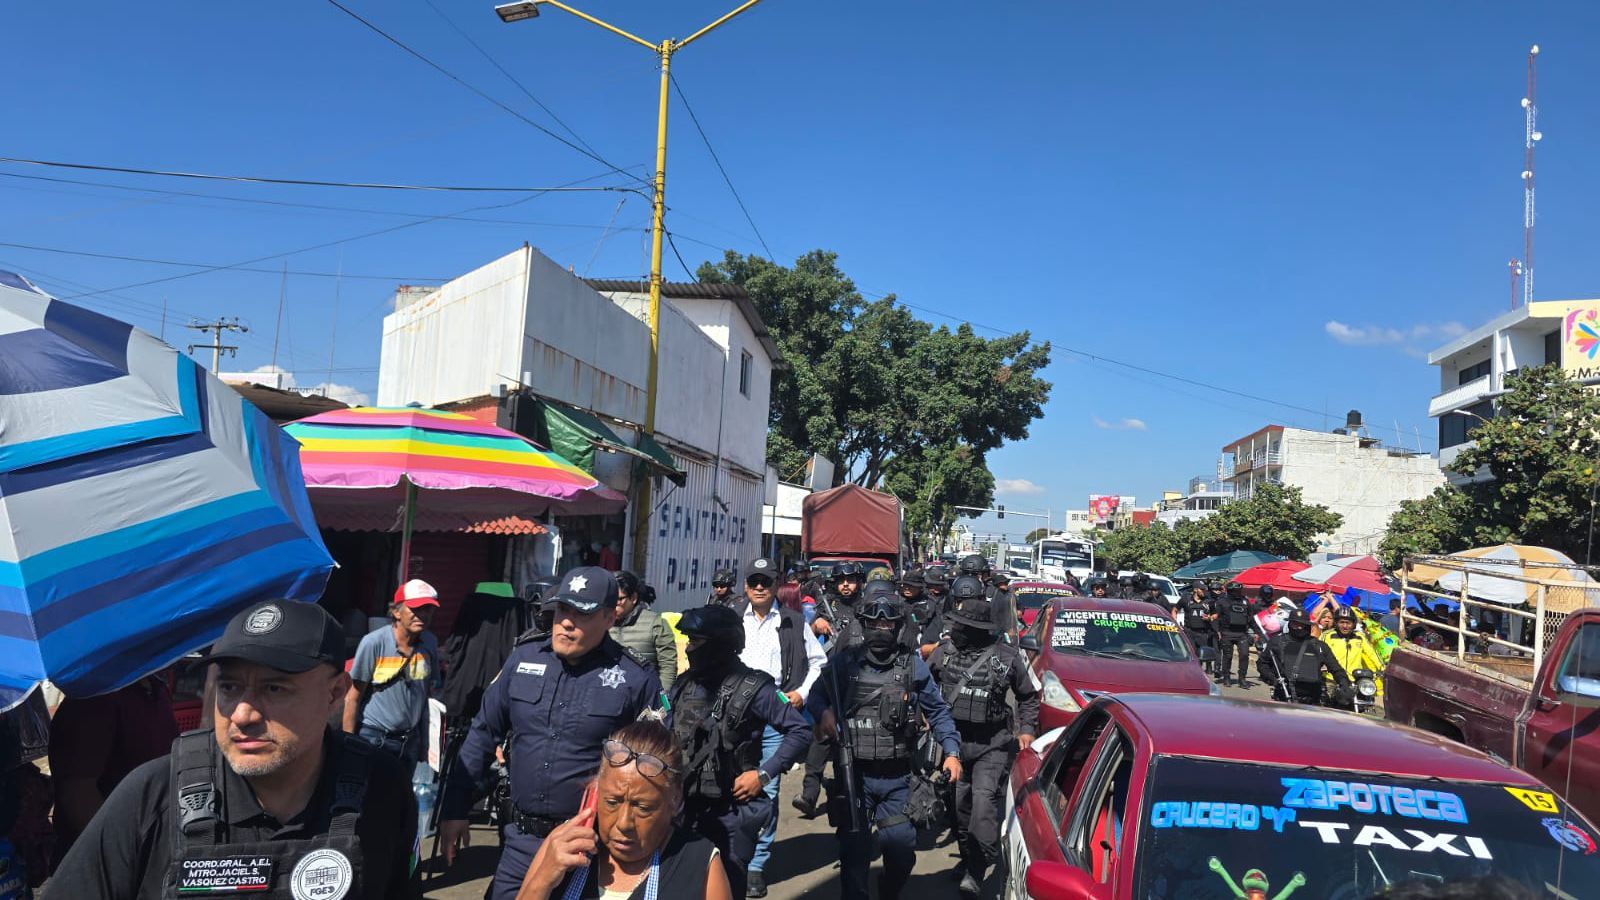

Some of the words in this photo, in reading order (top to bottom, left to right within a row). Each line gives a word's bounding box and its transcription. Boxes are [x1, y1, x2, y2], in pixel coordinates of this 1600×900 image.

[1065, 611, 1108, 620] VICENTE
[1110, 612, 1164, 625] GUERRERO
[1093, 619, 1137, 629] CRUCERO
[1522, 793, 1553, 808] 15
[1151, 801, 1260, 830] CRUCERO
[1261, 805, 1296, 832] Y
[1298, 820, 1493, 860] TAXI
[182, 878, 228, 887] VASQUEZ
[228, 876, 266, 885] CASTRO
